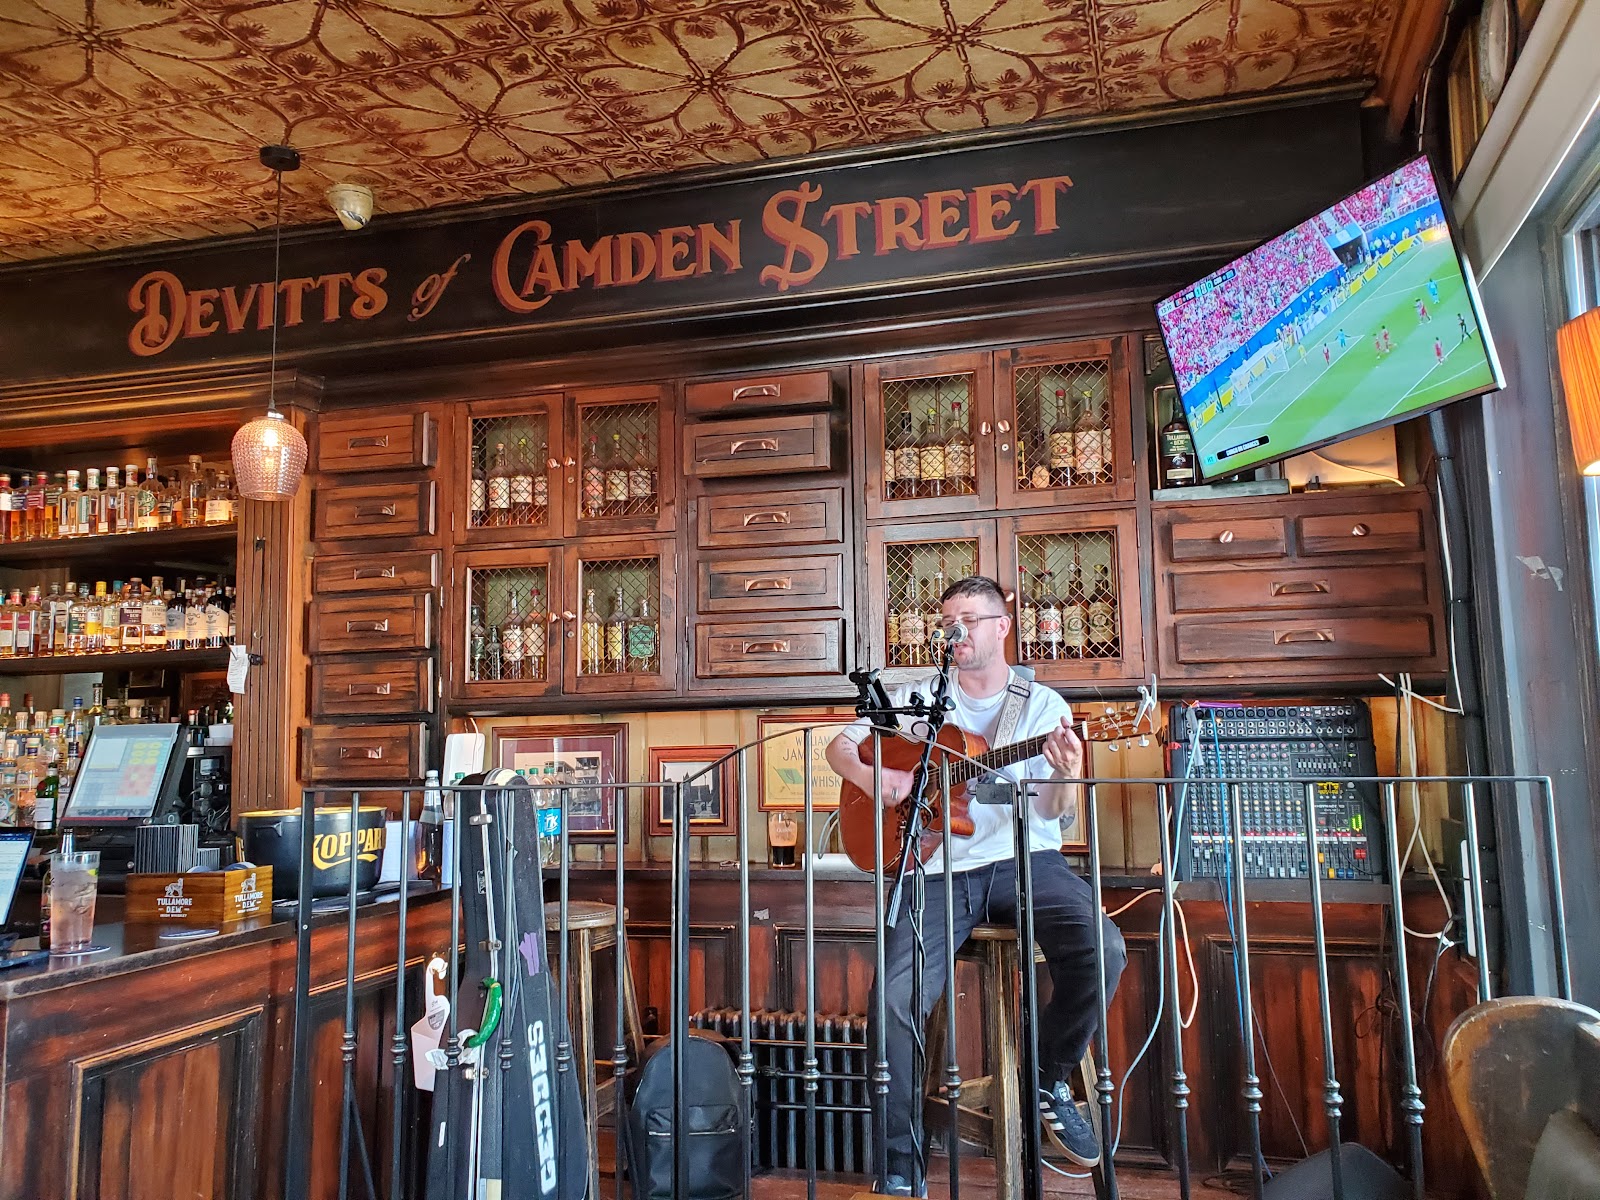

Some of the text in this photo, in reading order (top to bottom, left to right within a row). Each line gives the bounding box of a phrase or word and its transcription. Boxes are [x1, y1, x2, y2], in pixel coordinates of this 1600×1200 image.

[128, 175, 1075, 356] DEVITTS of CAMDEN STREET
[156, 898, 193, 906] TULLAMORE
[234, 891, 264, 903] TULLAMORE
